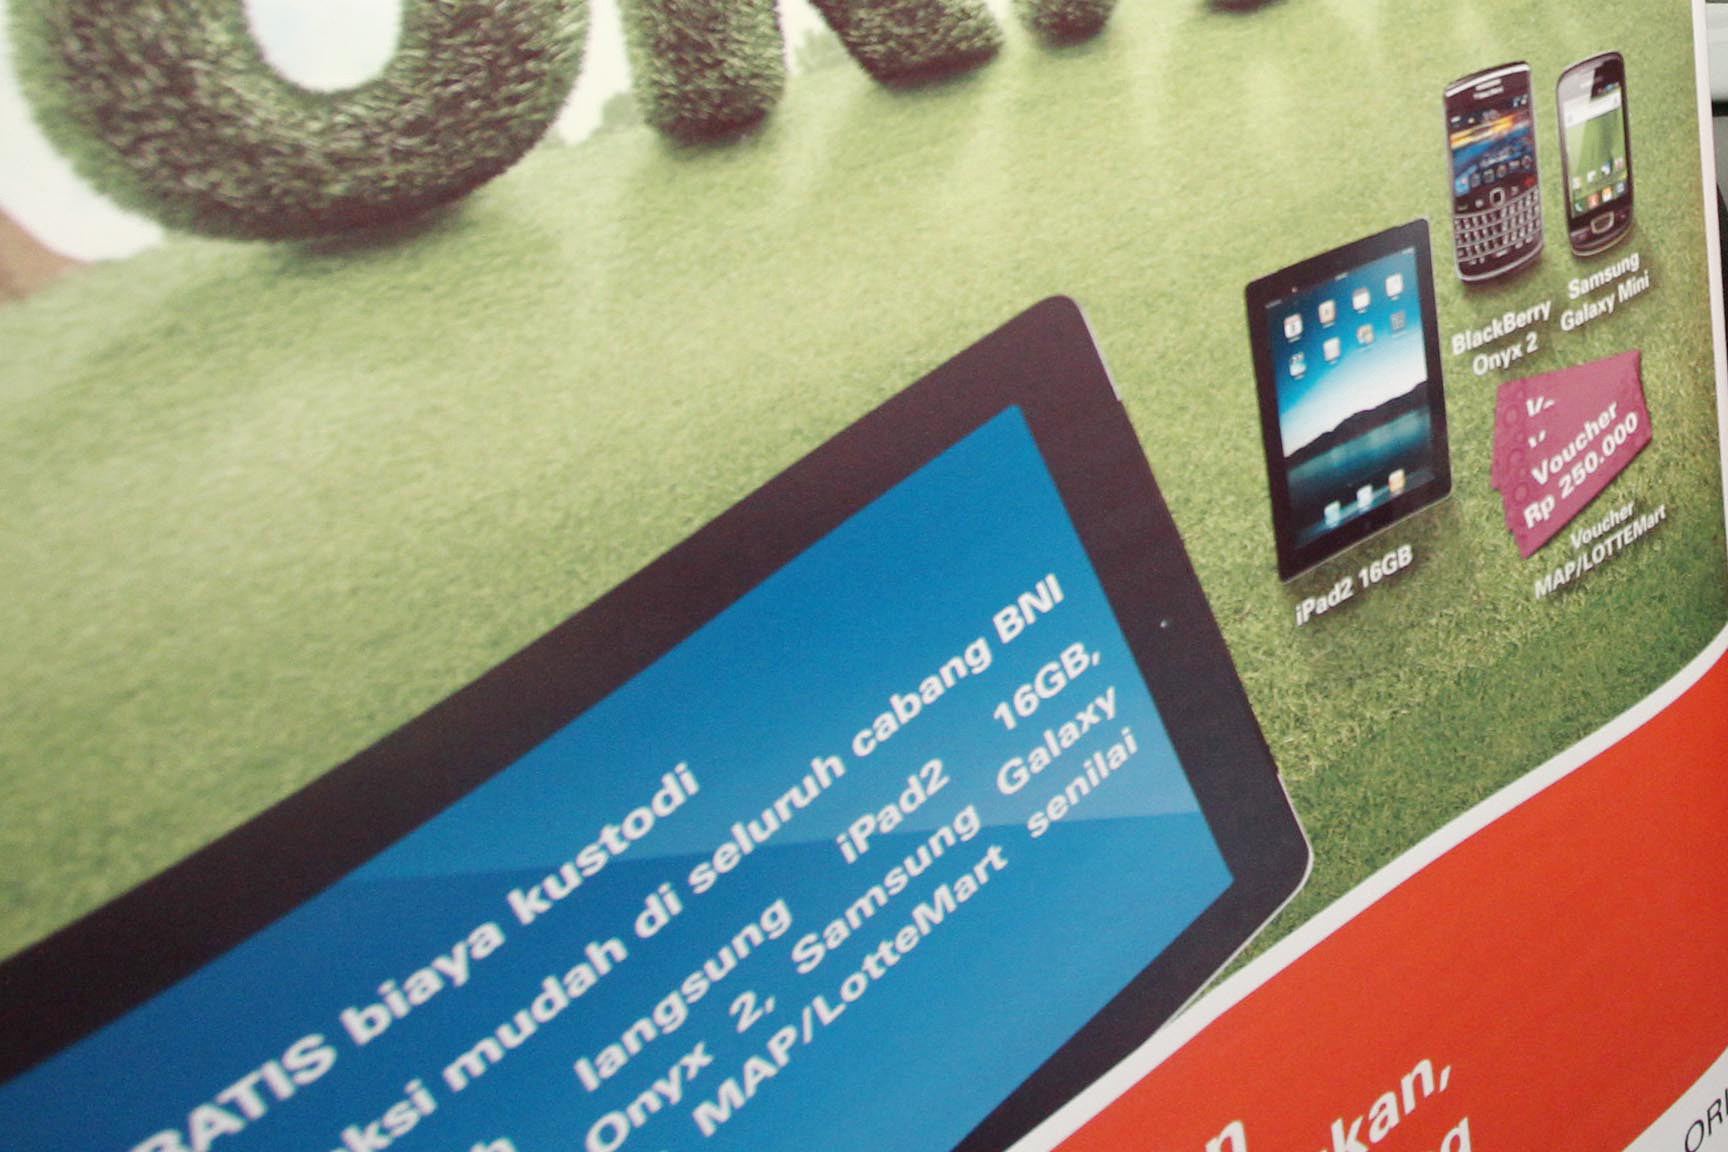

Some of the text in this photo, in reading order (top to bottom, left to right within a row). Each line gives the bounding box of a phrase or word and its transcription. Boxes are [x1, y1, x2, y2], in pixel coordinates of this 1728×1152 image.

[1560, 269, 1650, 331] Galaxy Mini
[1568, 252, 1640, 299] Samsung
[1452, 300, 1551, 356] BlackBerry
[1472, 331, 1538, 376] Onyx 2
[1523, 412, 1639, 529] Rp 250.000
[1531, 401, 1618, 485] Voucher
[1534, 504, 1666, 598] MAP/LOTTEMart
[1570, 501, 1634, 549] Voucher
[1295, 544, 1413, 626] iPad2 16GB
[330, 573, 1064, 1152] ksi mudah di seluruh cabang BNI
[340, 922, 505, 1045] biaya
[507, 762, 699, 925] kustodi
[574, 642, 1100, 1092] langsung iPad2 16GB,
[585, 686, 1116, 1152] Onyx 2, Samsung Galaxy
[692, 727, 1138, 1137] MAP/LotteMart senilai
[1318, 1058, 1452, 1152] kan,
